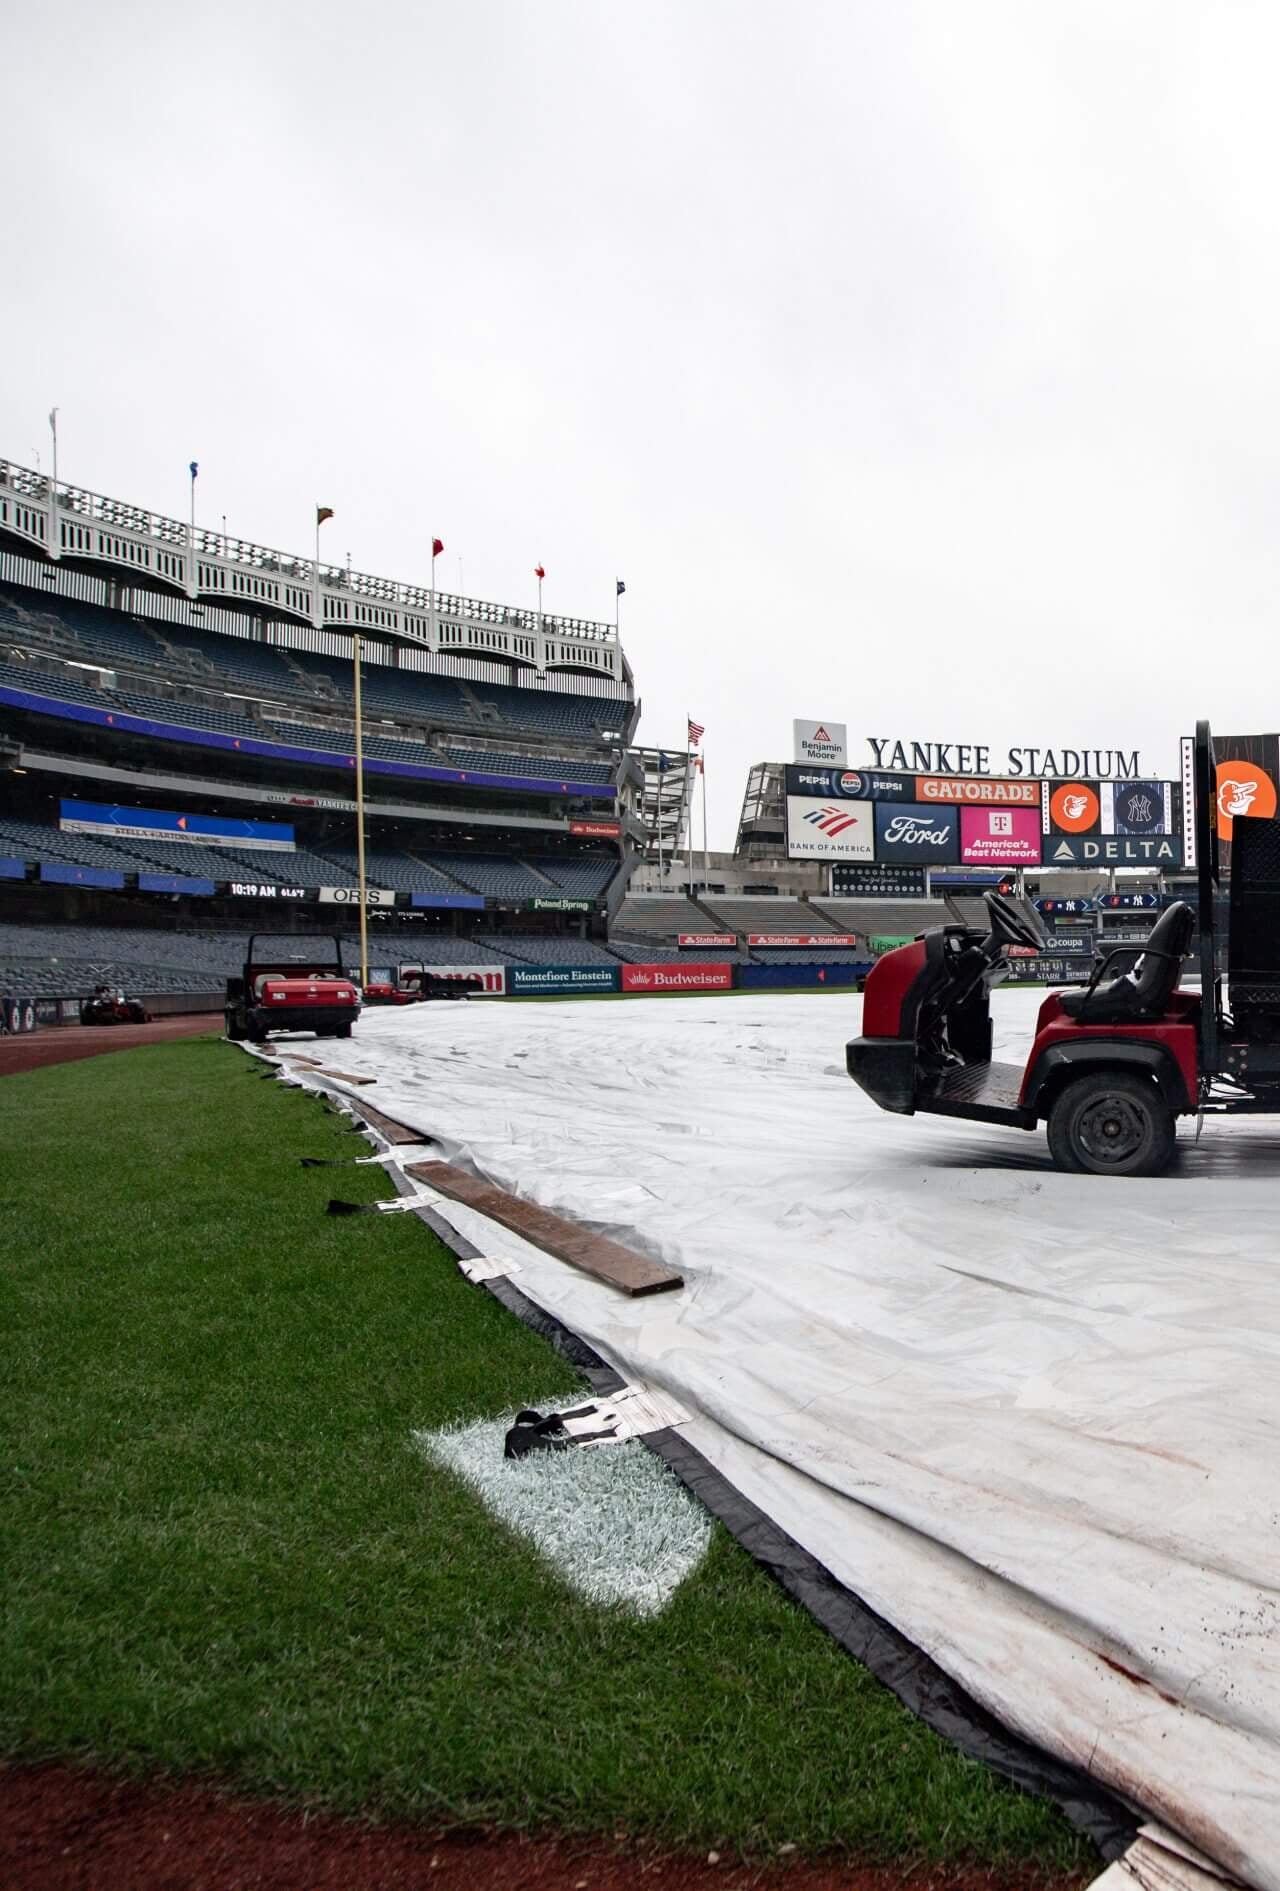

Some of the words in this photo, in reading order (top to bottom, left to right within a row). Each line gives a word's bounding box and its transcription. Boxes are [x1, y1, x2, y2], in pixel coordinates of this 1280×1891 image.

[802, 740, 842, 753] Benjamin
[807, 750, 836, 760] Moore
[866, 737, 990, 775] YANKEE
[1008, 748, 1141, 778] STADIUM
[799, 775, 830, 785] PEPSI
[872, 781, 903, 791] PEPSI
[923, 781, 1034, 801] GATORADE
[585, 826, 619, 835] Budweiser
[884, 816, 950, 845] Ford
[831, 845, 871, 853] AMERICA
[973, 839, 1029, 849] America's
[964, 848, 988, 857] Best
[990, 849, 1039, 858] Network
[1084, 841, 1173, 859] DELTA
[231, 883, 257, 896] 10:19
[259, 886, 277, 897] AM
[534, 898, 562, 910] Poland
[562, 899, 588, 911] Spring
[1058, 938, 1083, 948] coupa
[514, 971, 570, 981] Montefiore
[571, 970, 612, 980] Einstein
[654, 973, 727, 985] Budweiser
